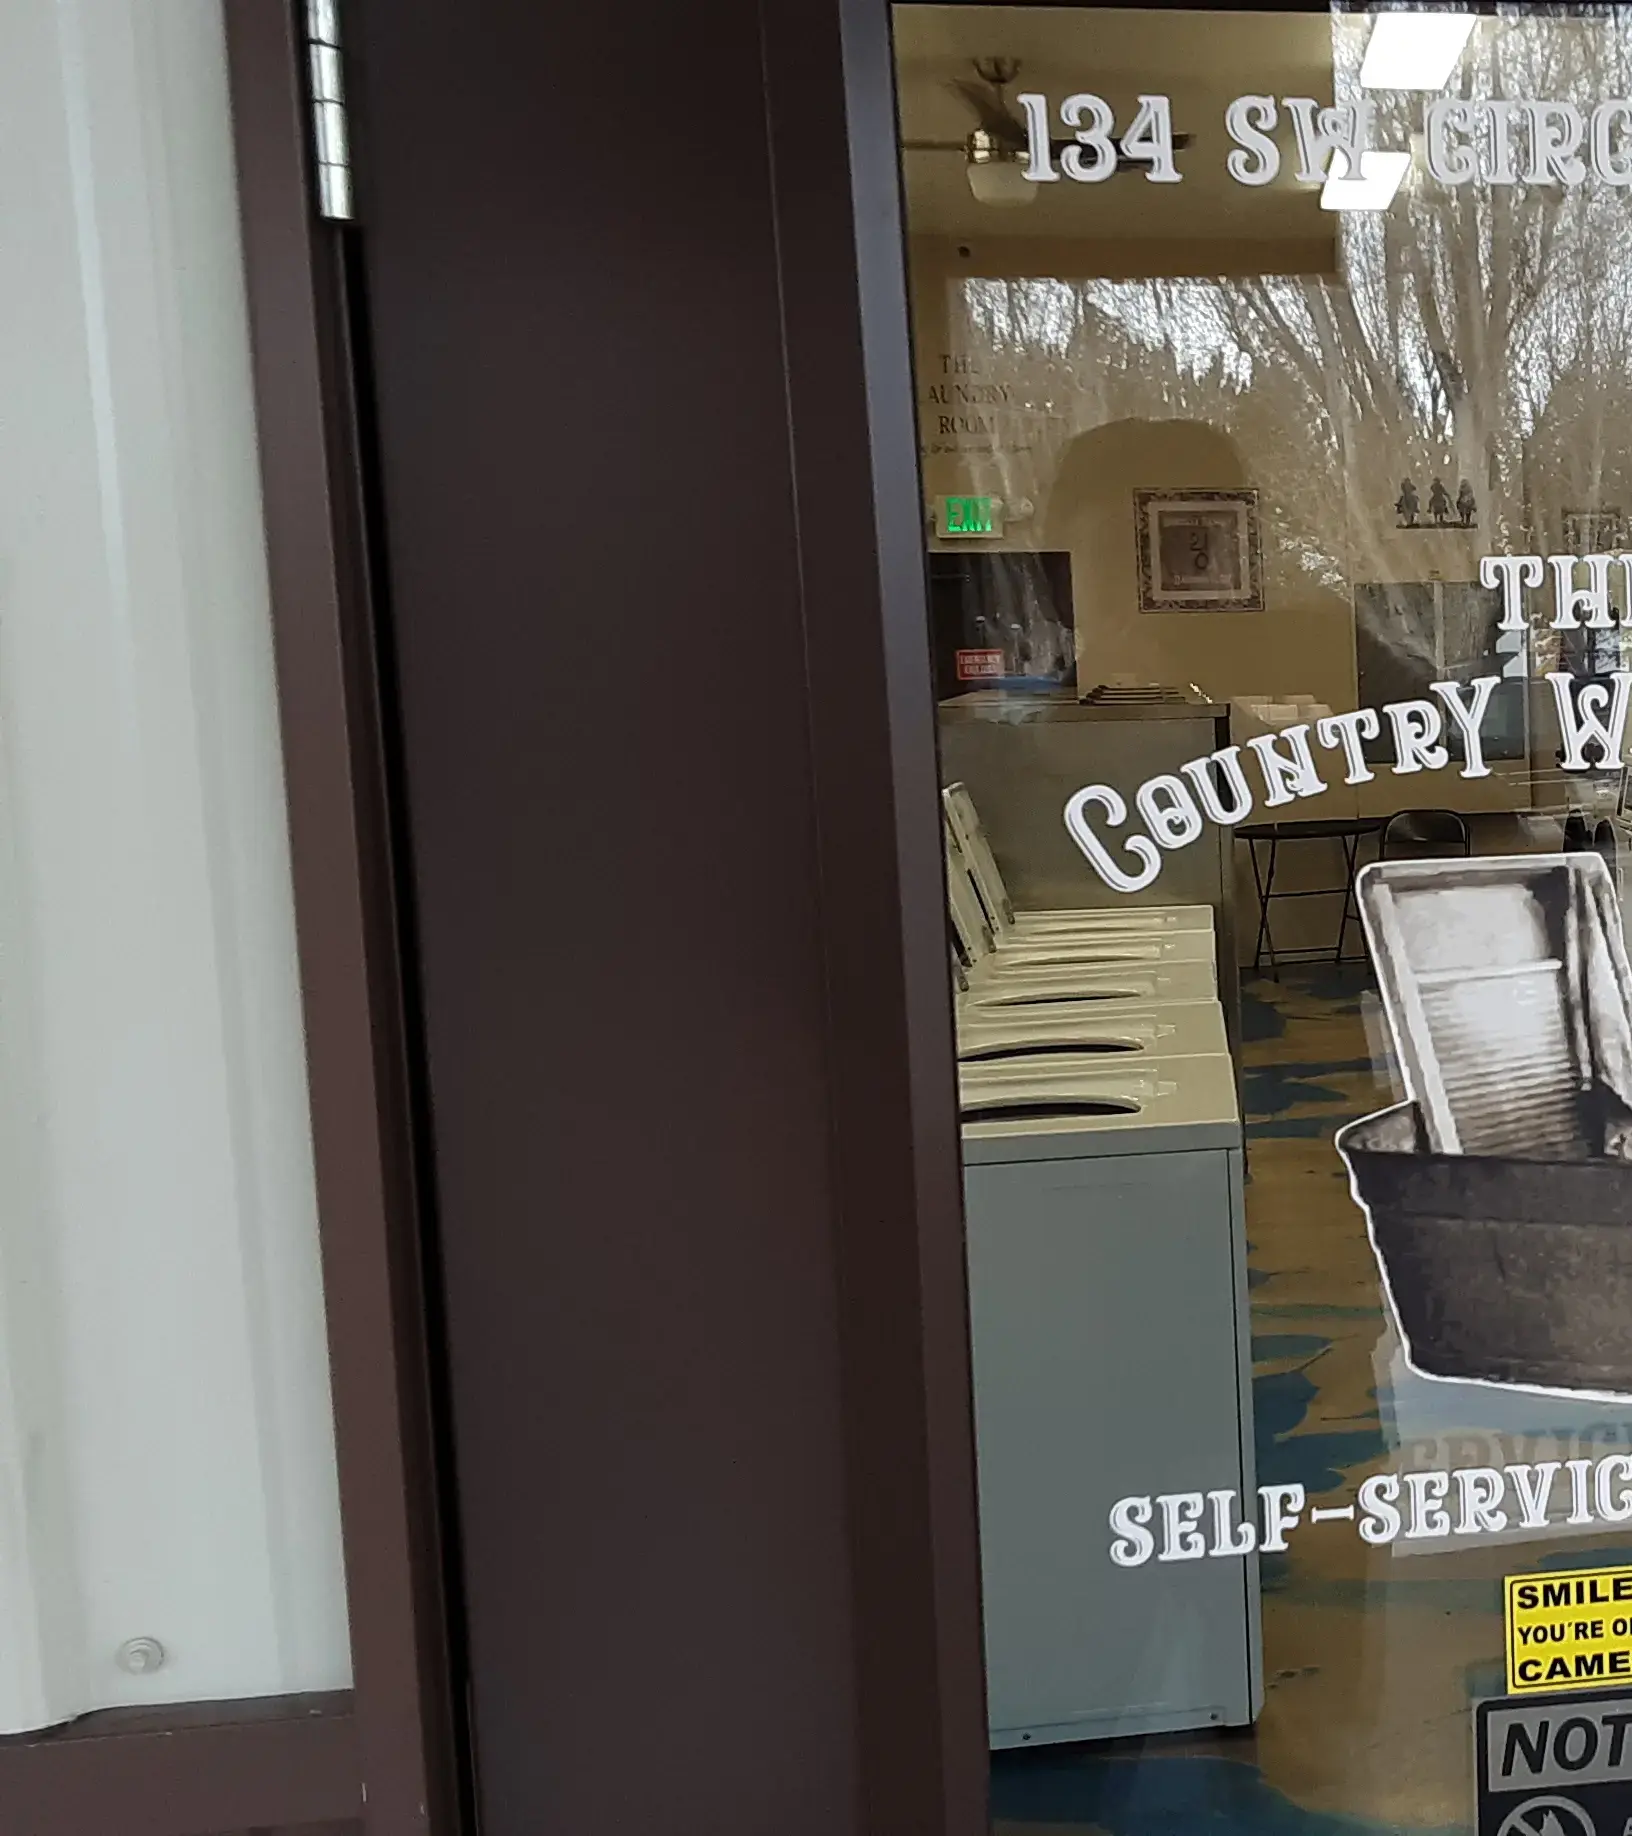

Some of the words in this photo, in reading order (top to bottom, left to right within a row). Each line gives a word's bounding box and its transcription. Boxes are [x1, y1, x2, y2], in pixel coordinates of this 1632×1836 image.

[1017, 94, 1183, 183] 134
[1225, 95, 1375, 186] SW
[946, 497, 993, 532] EXIT
[1517, 1620, 1604, 1645] YOU'RE
